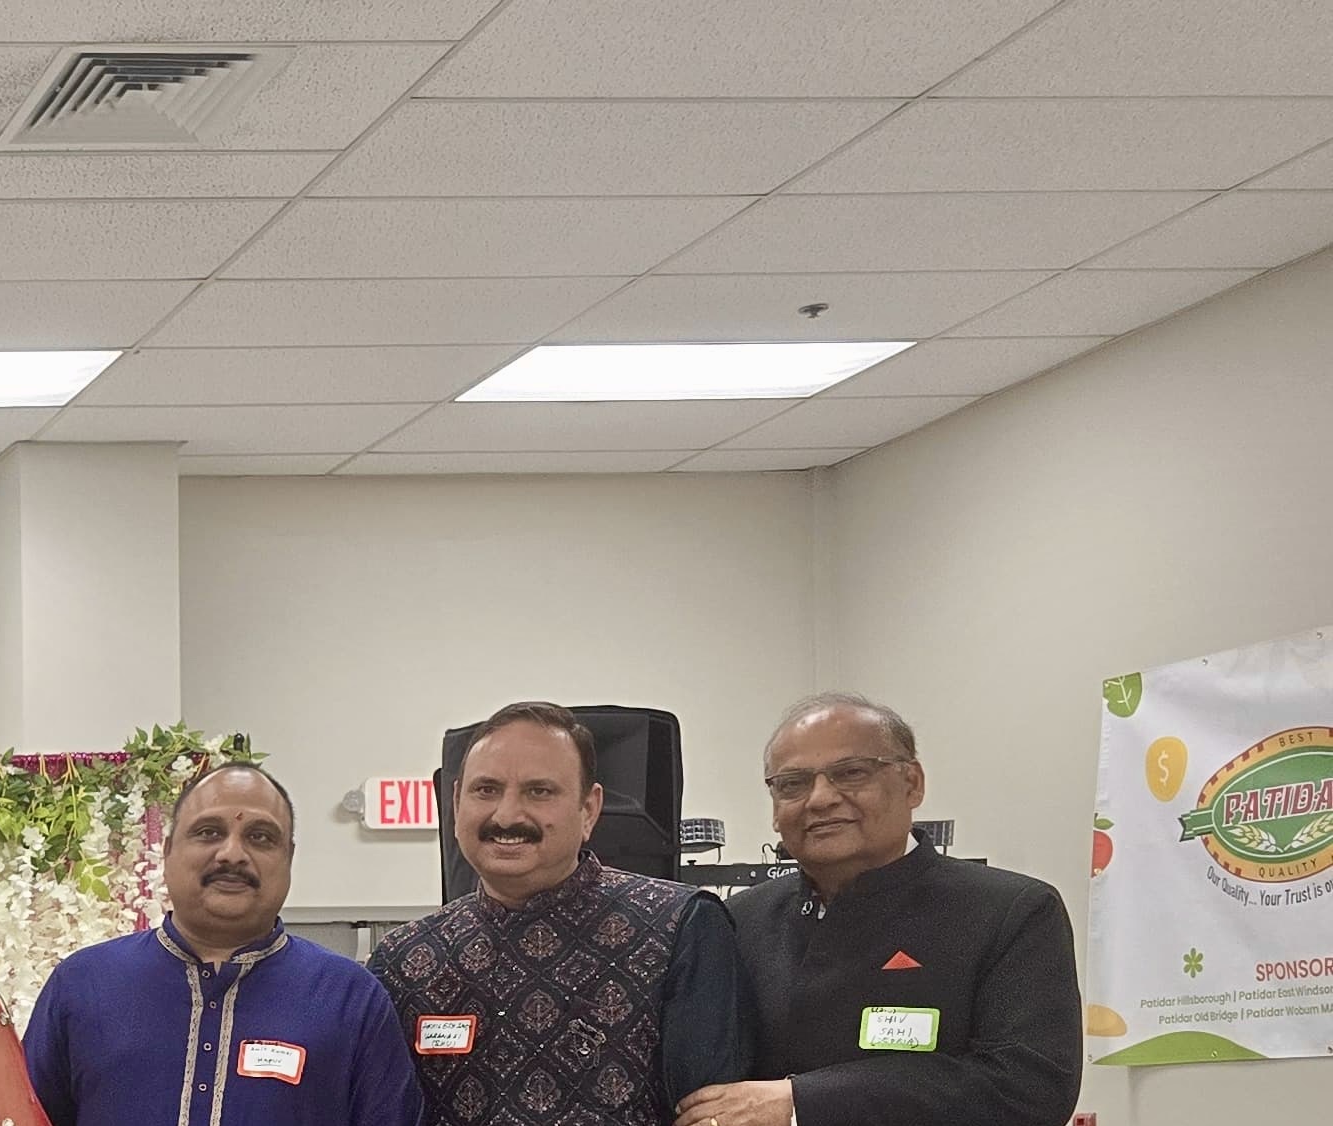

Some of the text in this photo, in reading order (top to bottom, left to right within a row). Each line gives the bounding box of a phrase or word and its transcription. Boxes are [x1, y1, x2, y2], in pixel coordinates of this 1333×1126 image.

[1278, 731, 1314, 748] BEST
[380, 780, 434, 825] EXIT
[1258, 858, 1318, 879] QUALITY
[1206, 865, 1221, 887] Our
[1259, 889, 1282, 907] Your
[1284, 885, 1313, 906] Trust
[1313, 883, 1324, 899] is
[1140, 997, 1175, 1009] Patidar
[1238, 988, 1276, 1001] Patidar
[1277, 987, 1295, 999] East
[1158, 1013, 1193, 1025] Patidar
[1193, 1011, 1209, 1022] Old
[1209, 1009, 1238, 1023] Bridge
[1246, 1005, 1284, 1019] Patidar
